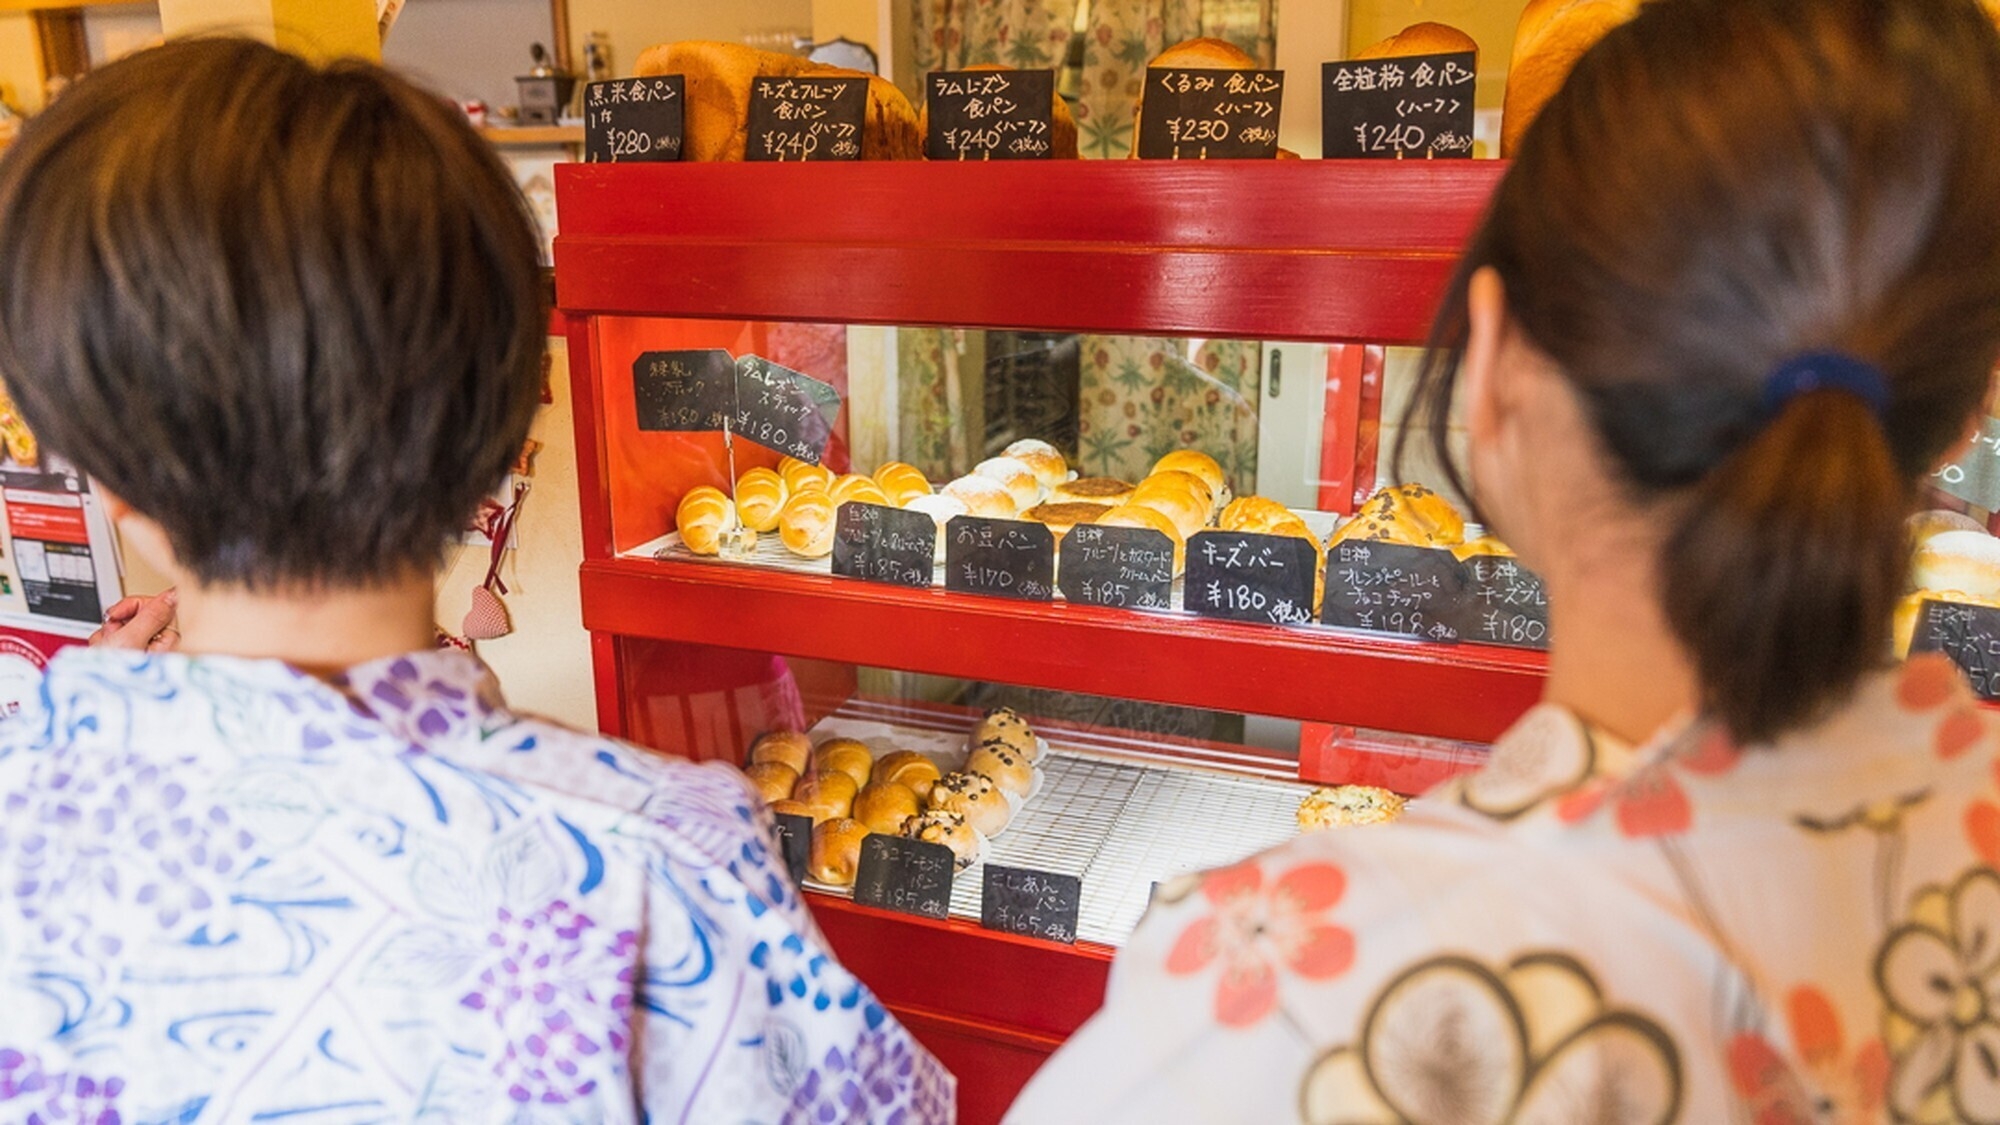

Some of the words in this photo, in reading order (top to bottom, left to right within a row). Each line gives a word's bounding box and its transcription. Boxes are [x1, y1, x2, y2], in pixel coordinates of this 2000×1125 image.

[1161, 72, 1214, 93] くるみ
[1223, 72, 1280, 94] 食パン
[1410, 61, 1475, 88] 食パン
[589, 79, 676, 107] 黒米食パン
[758, 80, 847, 101] チーズとフルーツ
[773, 100, 827, 120] 食パン
[962, 97, 1018, 119] 食パン
[606, 127, 651, 155] ¥280
[762, 130, 818, 155] ¥240
[942, 128, 1001, 151] ¥240
[1166, 117, 1230, 143] ¥230
[1353, 122, 1425, 153] ¥240
[739, 410, 788, 446] ¥180
[956, 524, 1037, 551] お豆パン
[1201, 539, 1285, 570] チーズバー
[961, 561, 1014, 588] ¥170
[1081, 577, 1130, 607] ¥185
[1206, 579, 1267, 611] ¥180
[1482, 609, 1546, 642] ¥180
[992, 874, 1059, 894] こしあん
[1034, 895, 1070, 912] パン
